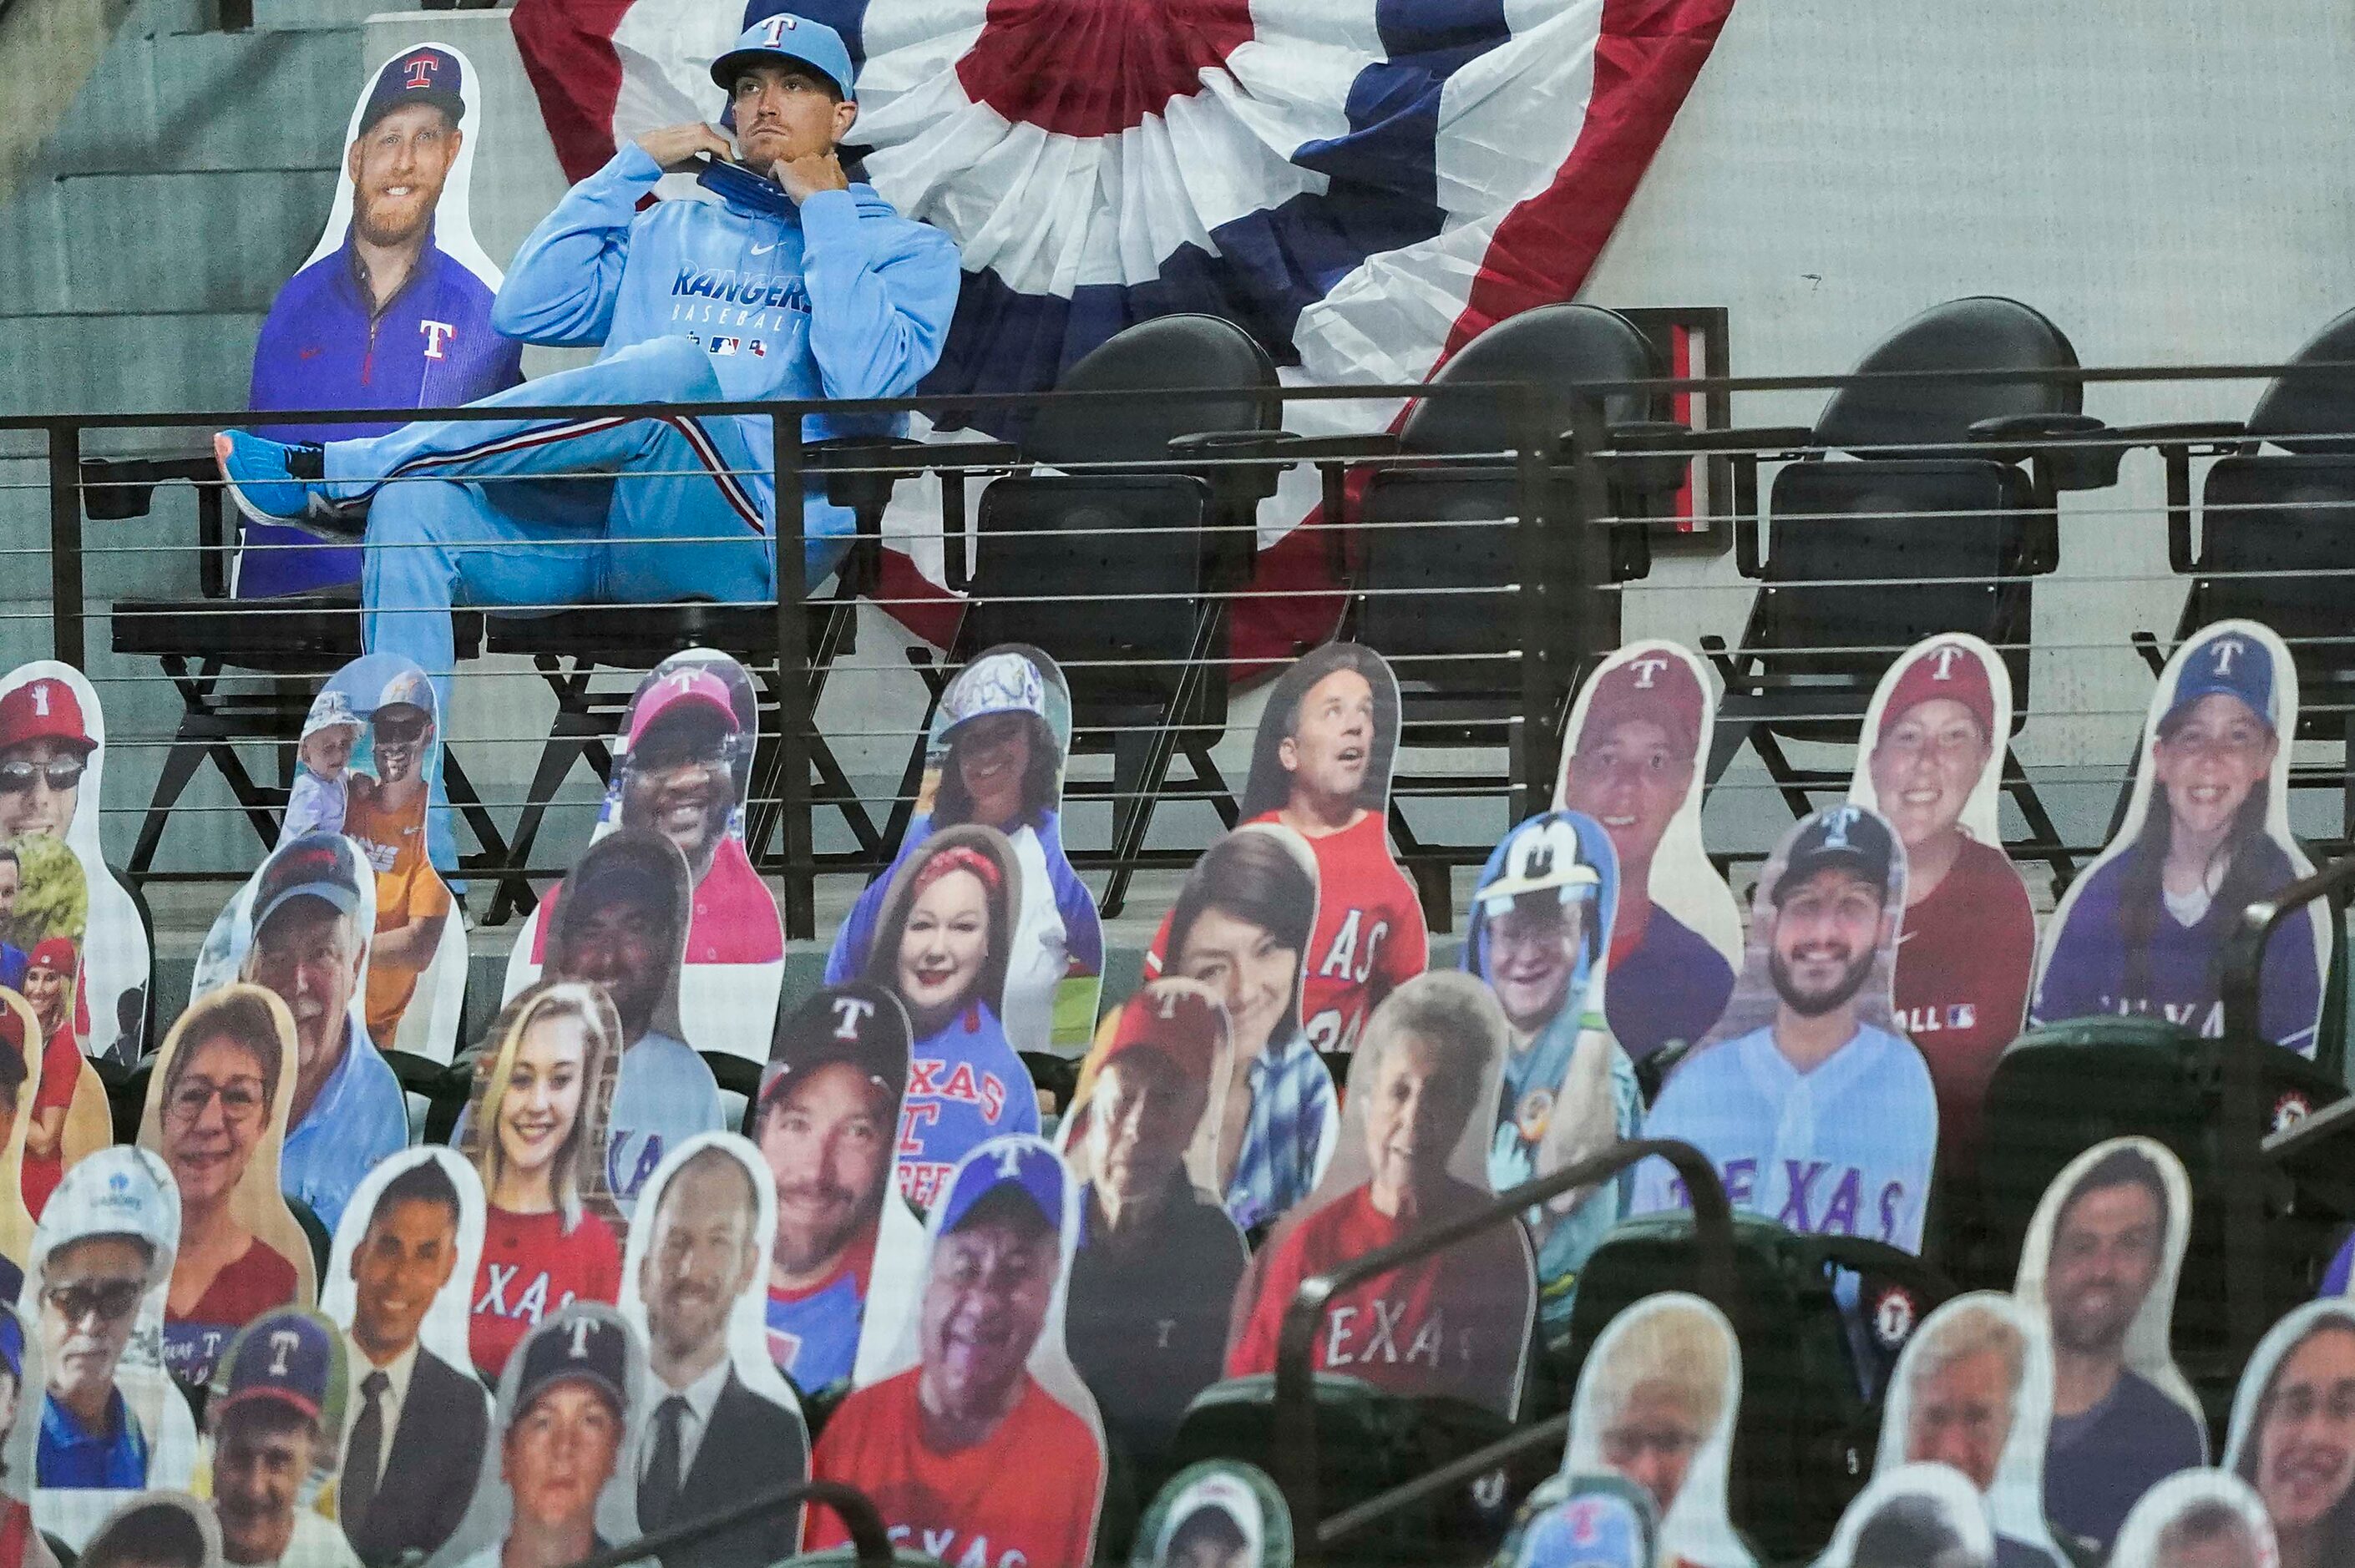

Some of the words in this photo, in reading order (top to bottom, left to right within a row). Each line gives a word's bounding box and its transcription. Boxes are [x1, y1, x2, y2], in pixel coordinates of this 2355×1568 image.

[761, 17, 797, 48] T
[404, 55, 438, 89] T
[419, 320, 456, 360] T
[1630, 659, 1669, 689] T
[1927, 646, 1963, 680] T
[2210, 640, 2244, 675] T
[670, 671, 700, 694] T
[1821, 807, 1861, 847] T
[1304, 908, 1390, 984] AS
[832, 997, 875, 1039] T
[907, 1059, 1006, 1125] XAS
[990, 1143, 1037, 1179] T
[471, 1262, 576, 1326] XA
[269, 1330, 301, 1377] T
[564, 1316, 600, 1358] T
